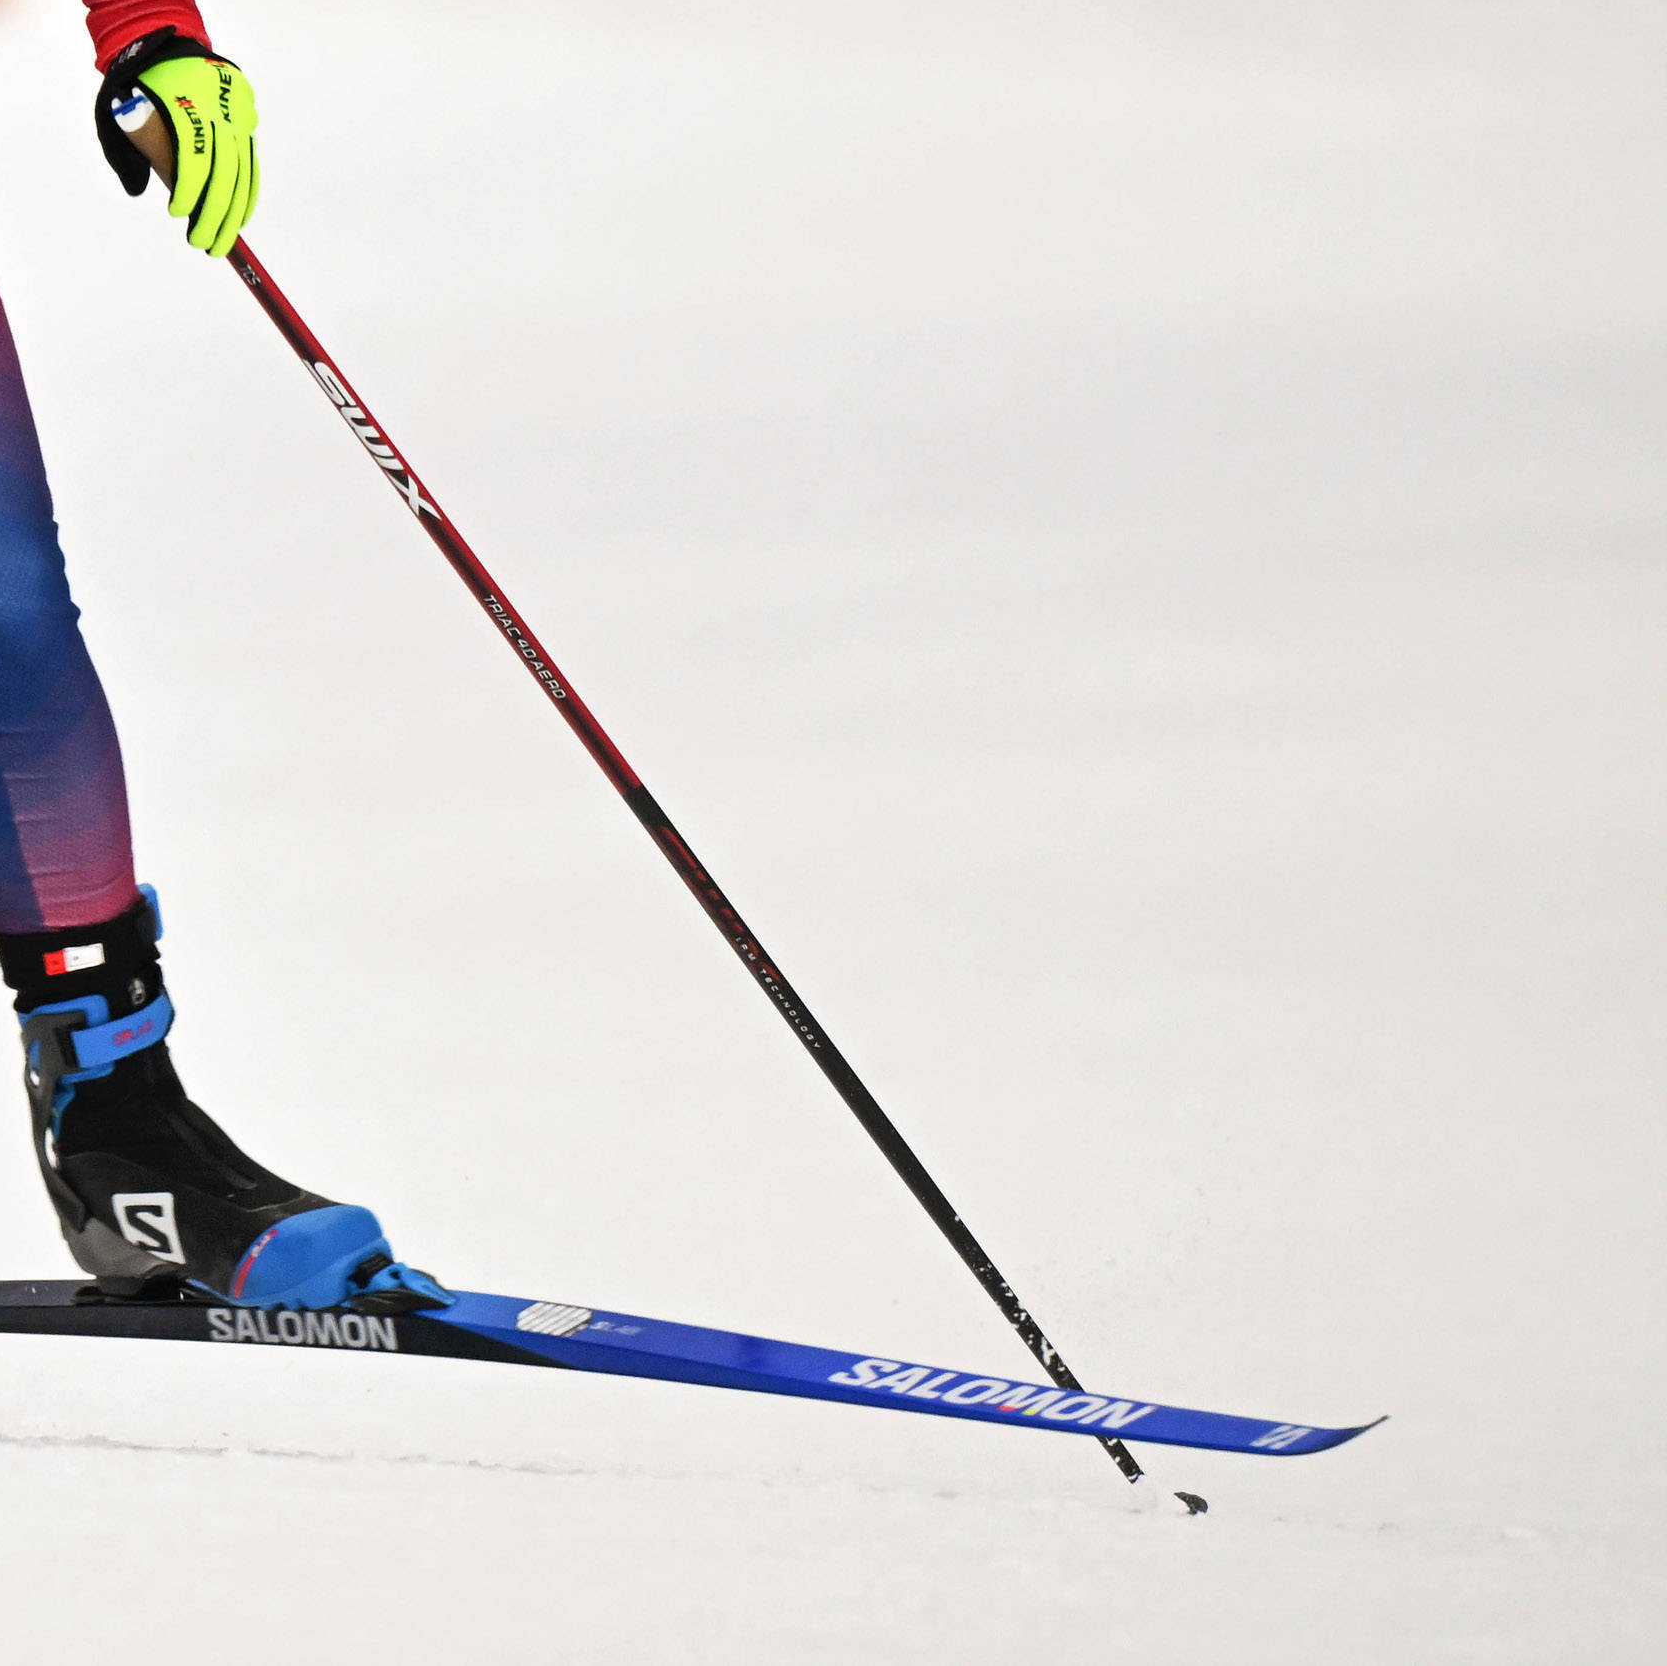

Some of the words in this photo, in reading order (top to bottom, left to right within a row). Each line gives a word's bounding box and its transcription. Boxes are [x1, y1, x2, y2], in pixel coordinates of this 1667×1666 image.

[302, 358, 443, 521] SWIX
[484, 594, 522, 637] TRIAC
[207, 1308, 399, 1352] SALOMON
[828, 1357, 1158, 1429] SALOMON
